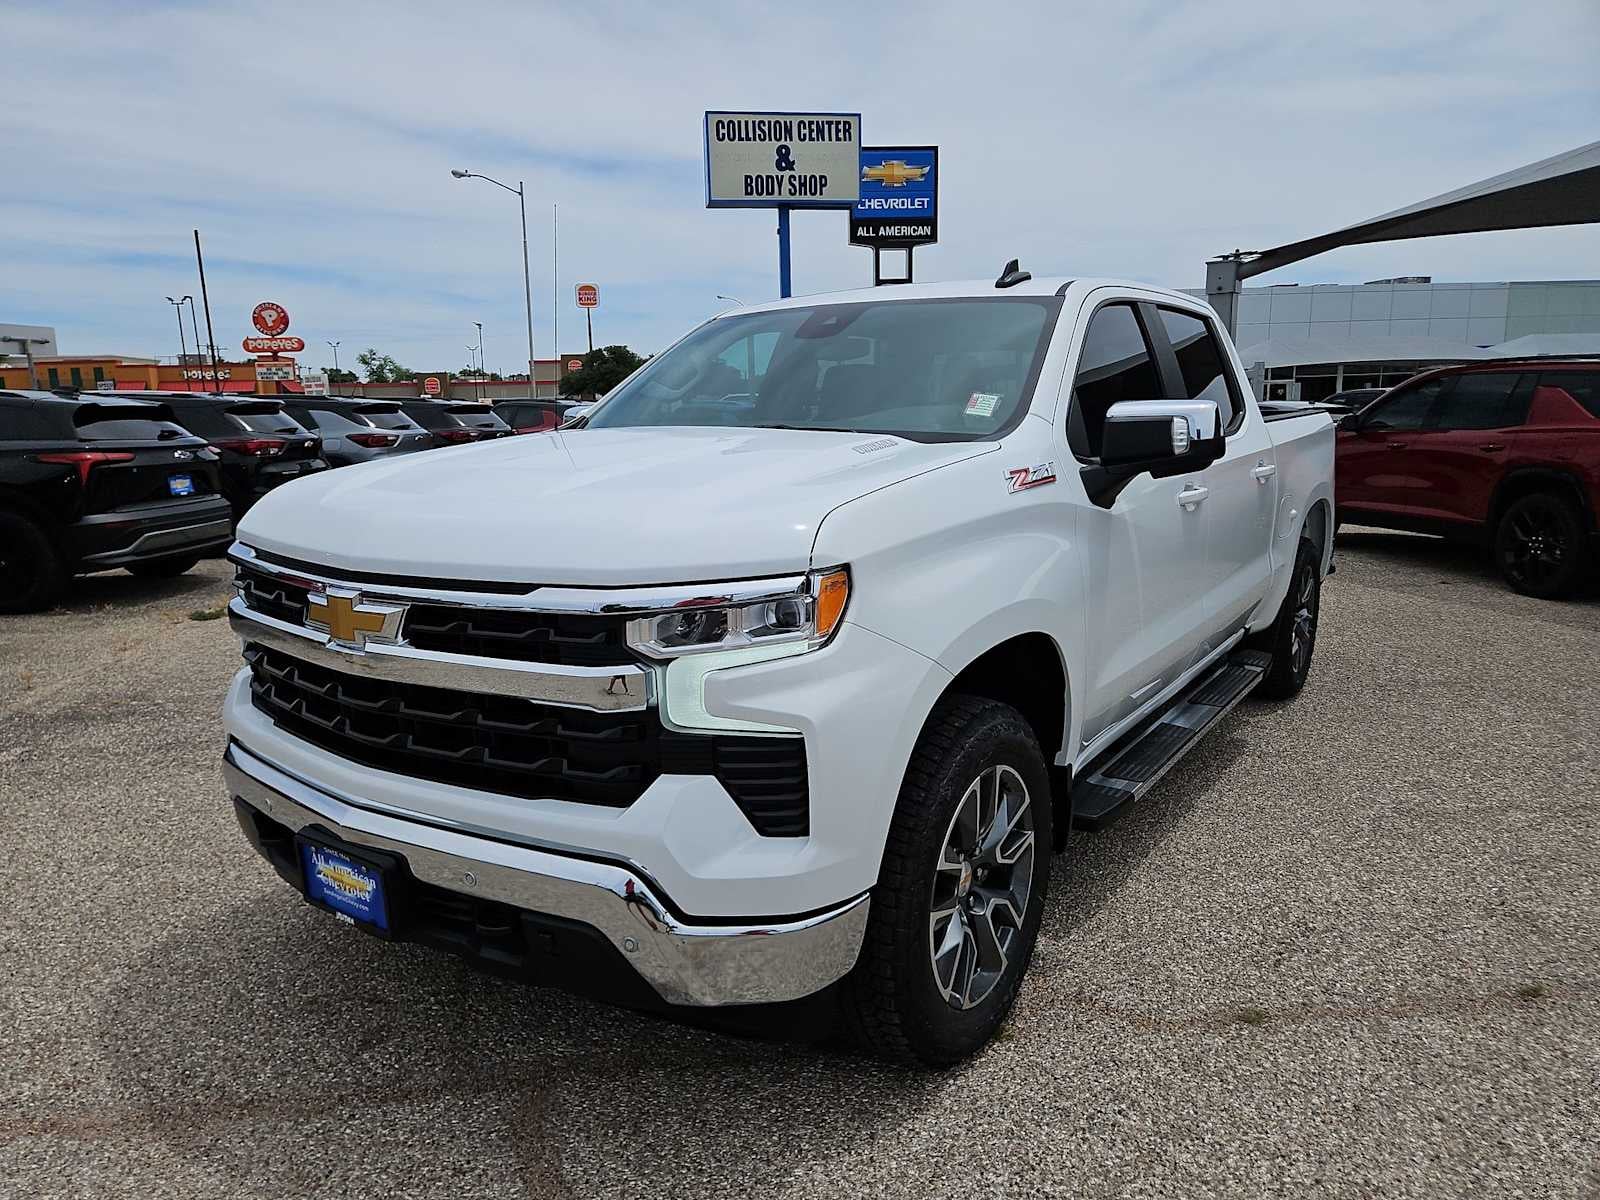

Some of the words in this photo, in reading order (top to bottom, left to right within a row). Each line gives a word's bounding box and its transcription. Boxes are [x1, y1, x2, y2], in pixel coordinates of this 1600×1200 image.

[715, 119, 793, 142] COLLISION
[797, 120, 852, 142] CENTER
[775, 144, 795, 171] &
[744, 174, 785, 196] BODY
[788, 174, 828, 196] SHOP
[857, 226, 875, 237] ALL
[878, 225, 931, 237] AMERICAN
[1003, 461, 1057, 494] Z71
